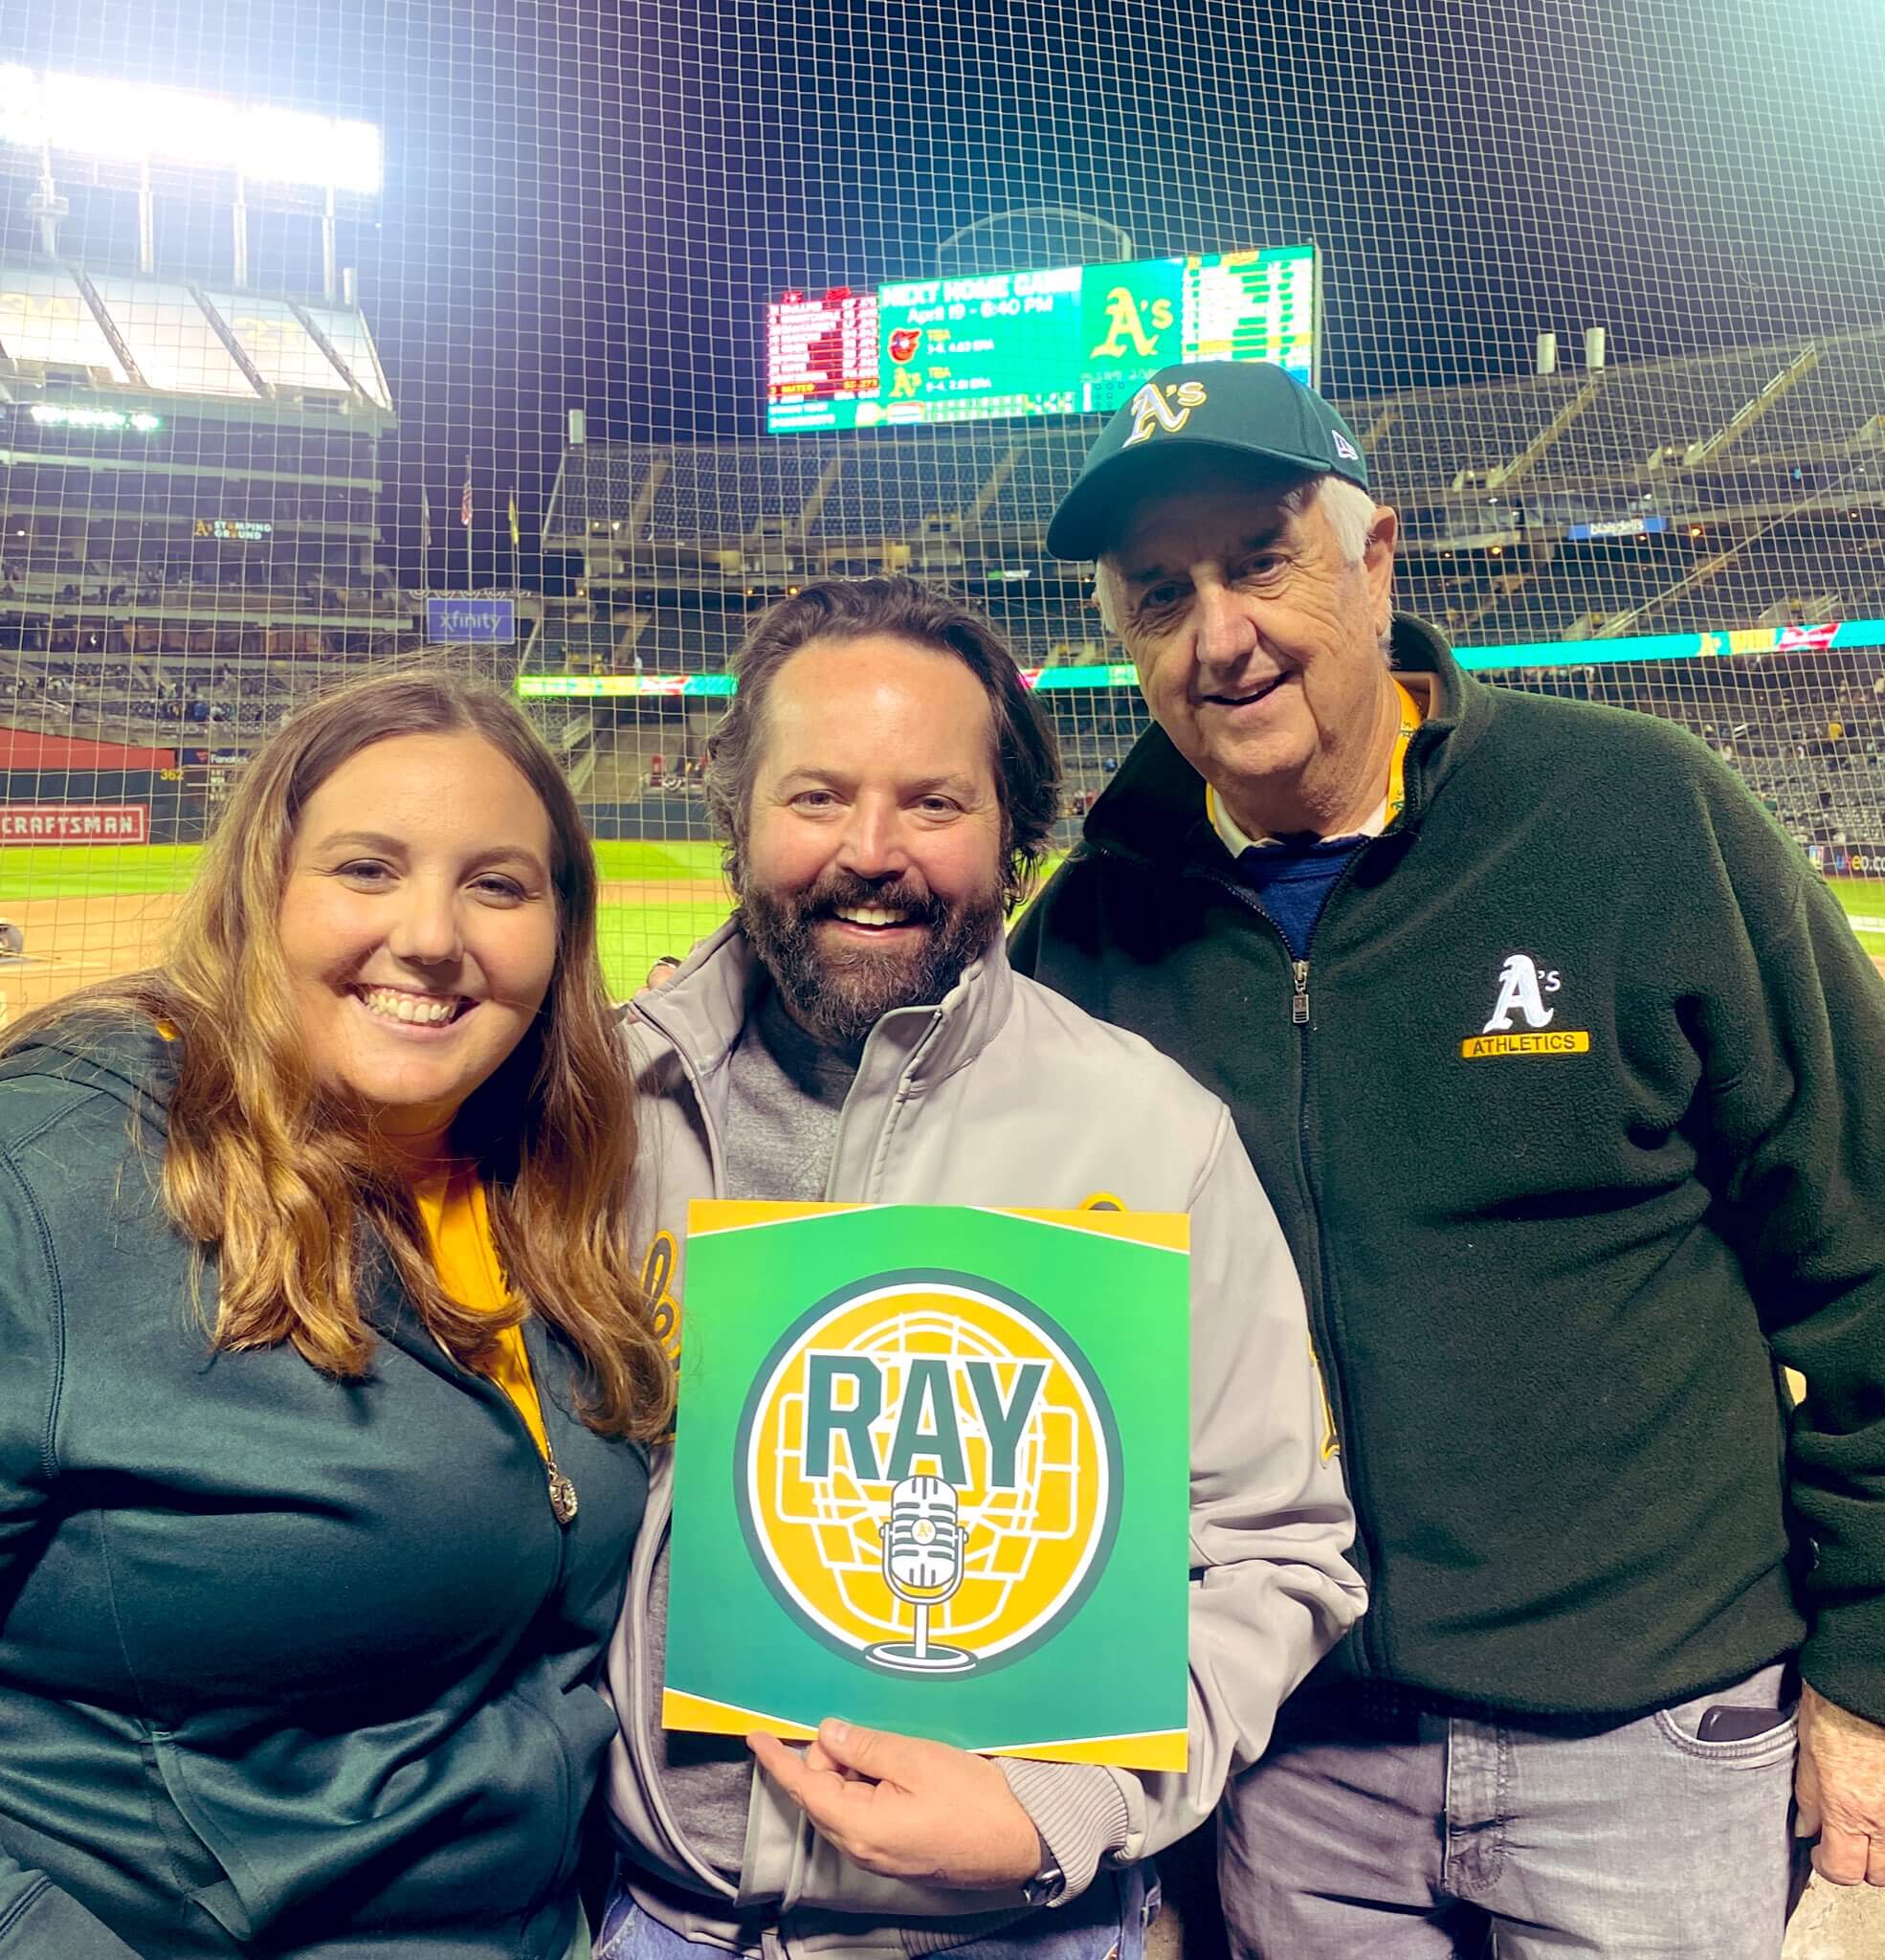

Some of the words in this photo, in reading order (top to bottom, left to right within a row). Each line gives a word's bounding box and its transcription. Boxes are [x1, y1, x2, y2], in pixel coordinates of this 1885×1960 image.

[1013, 267, 1082, 297] GA
[1090, 286, 1174, 359] A's
[1122, 381, 1208, 449] A's
[440, 610, 502, 634] xfinity
[160, 768, 185, 781] 362
[1, 815, 134, 835] CRAFTSMAN
[1483, 954, 1562, 1035] A's
[1473, 1035, 1576, 1056] ATHLETICS
[805, 1353, 1049, 1489] RAY
